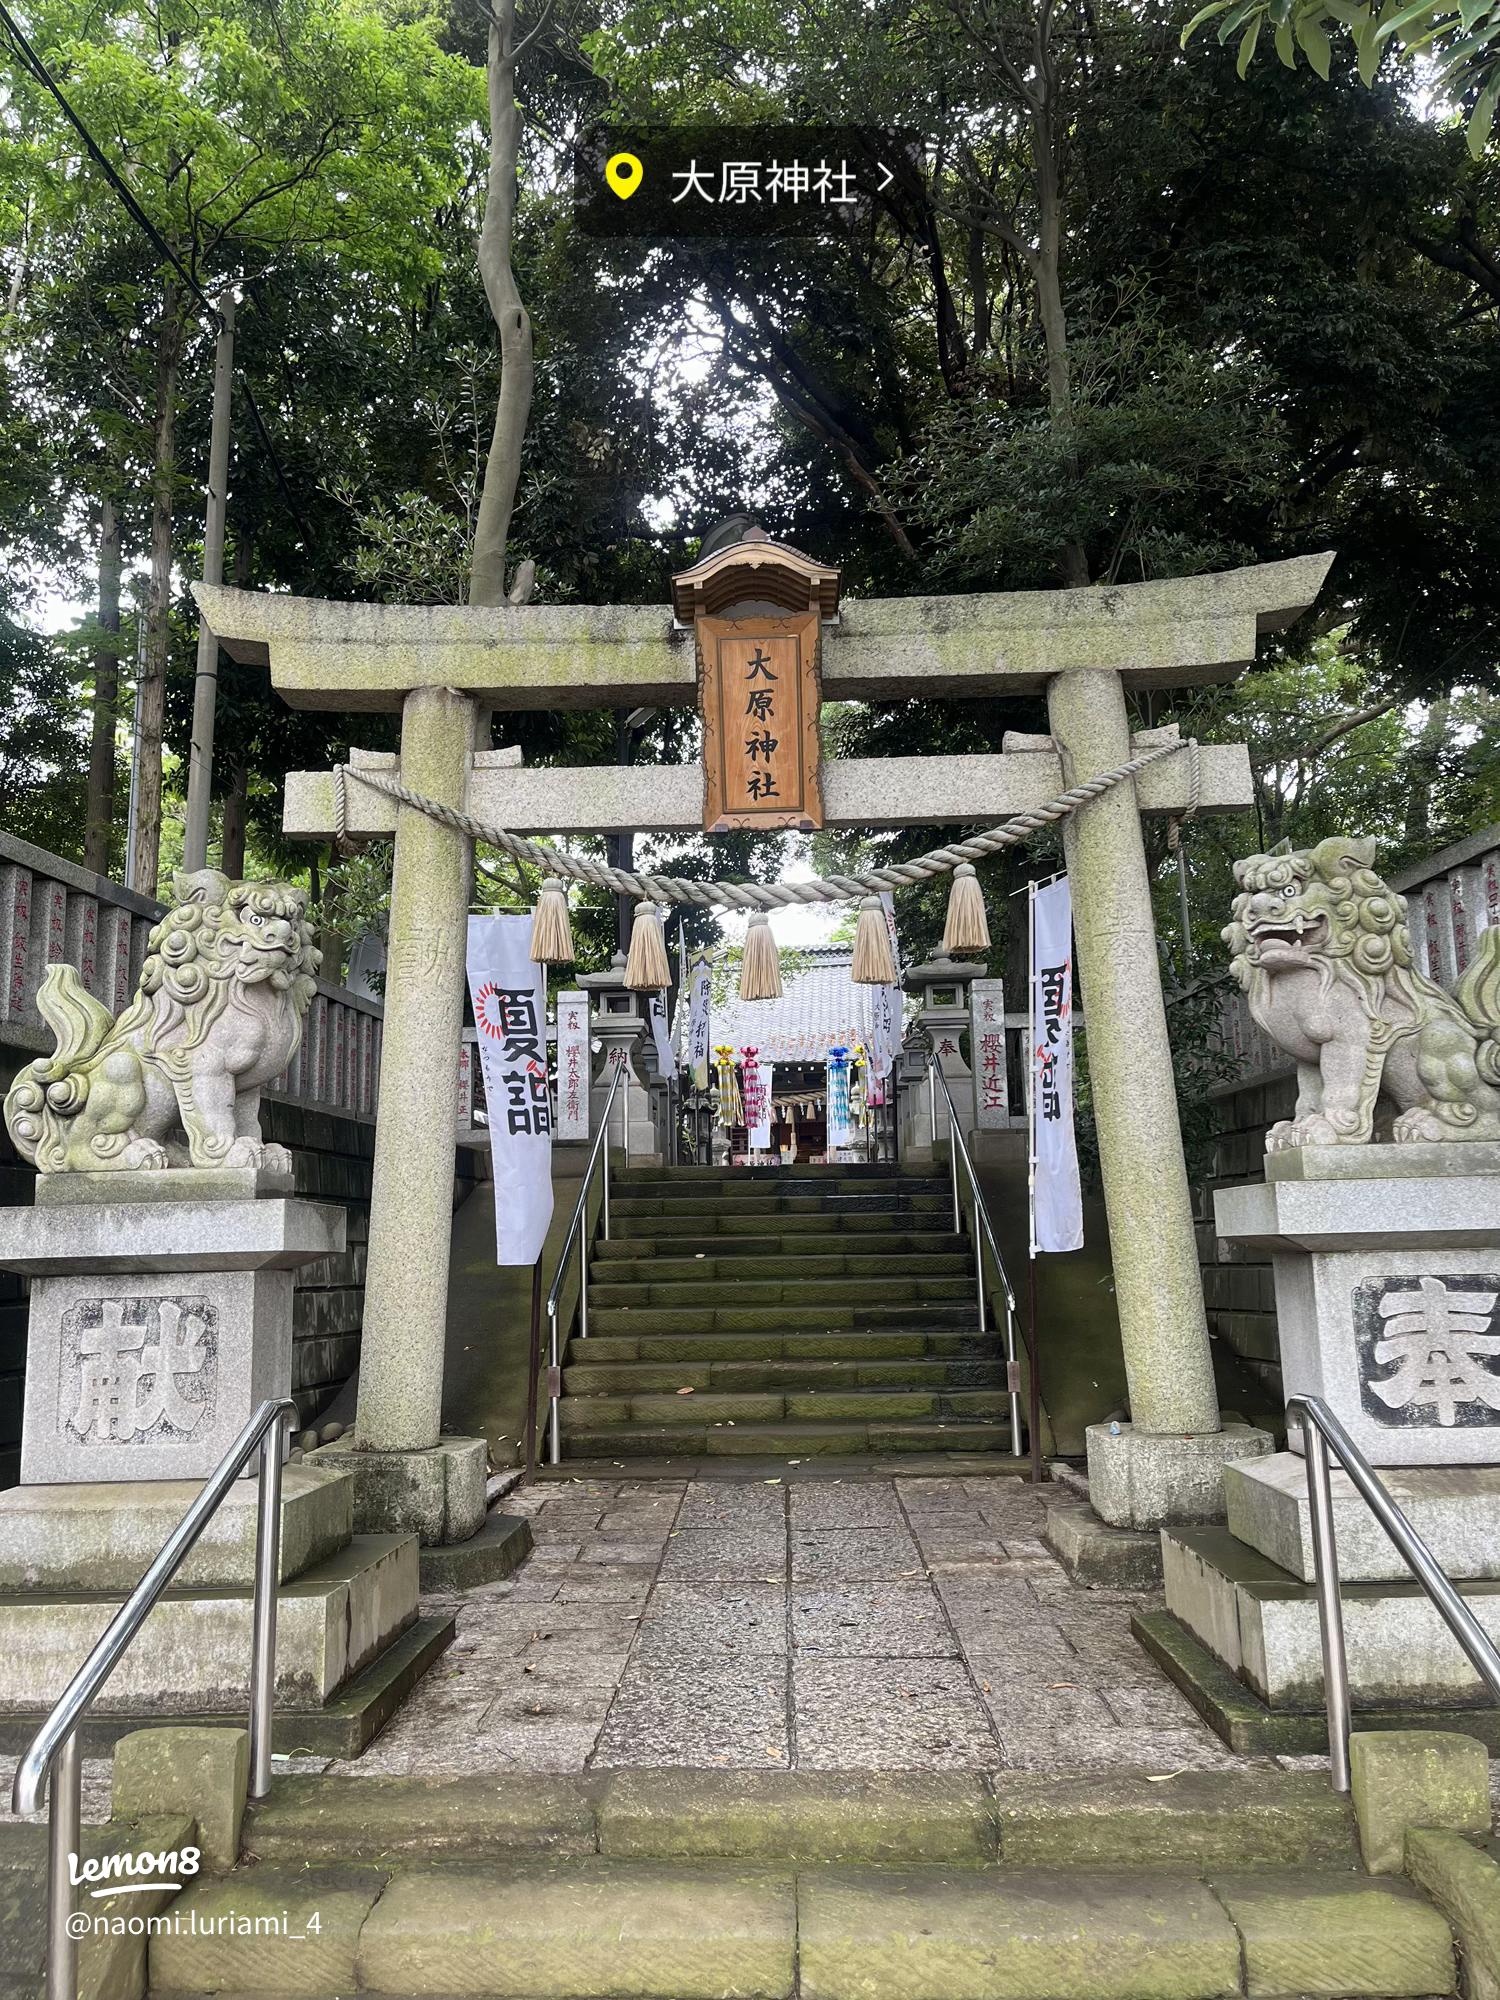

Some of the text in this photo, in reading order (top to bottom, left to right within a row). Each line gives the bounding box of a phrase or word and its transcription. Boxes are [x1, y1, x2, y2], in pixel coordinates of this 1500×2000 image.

[744, 648, 780, 801] 大原神社
[481, 1046, 494, 1092] なつもうで
[491, 988, 552, 1136] 夏詣
[609, 1047, 628, 1065] 納
[938, 1038, 957, 1057] 奉
[980, 1033, 1004, 1111] 櫻井近江
[72, 1300, 208, 1441] 献
[1367, 1276, 1500, 1427] 奉
